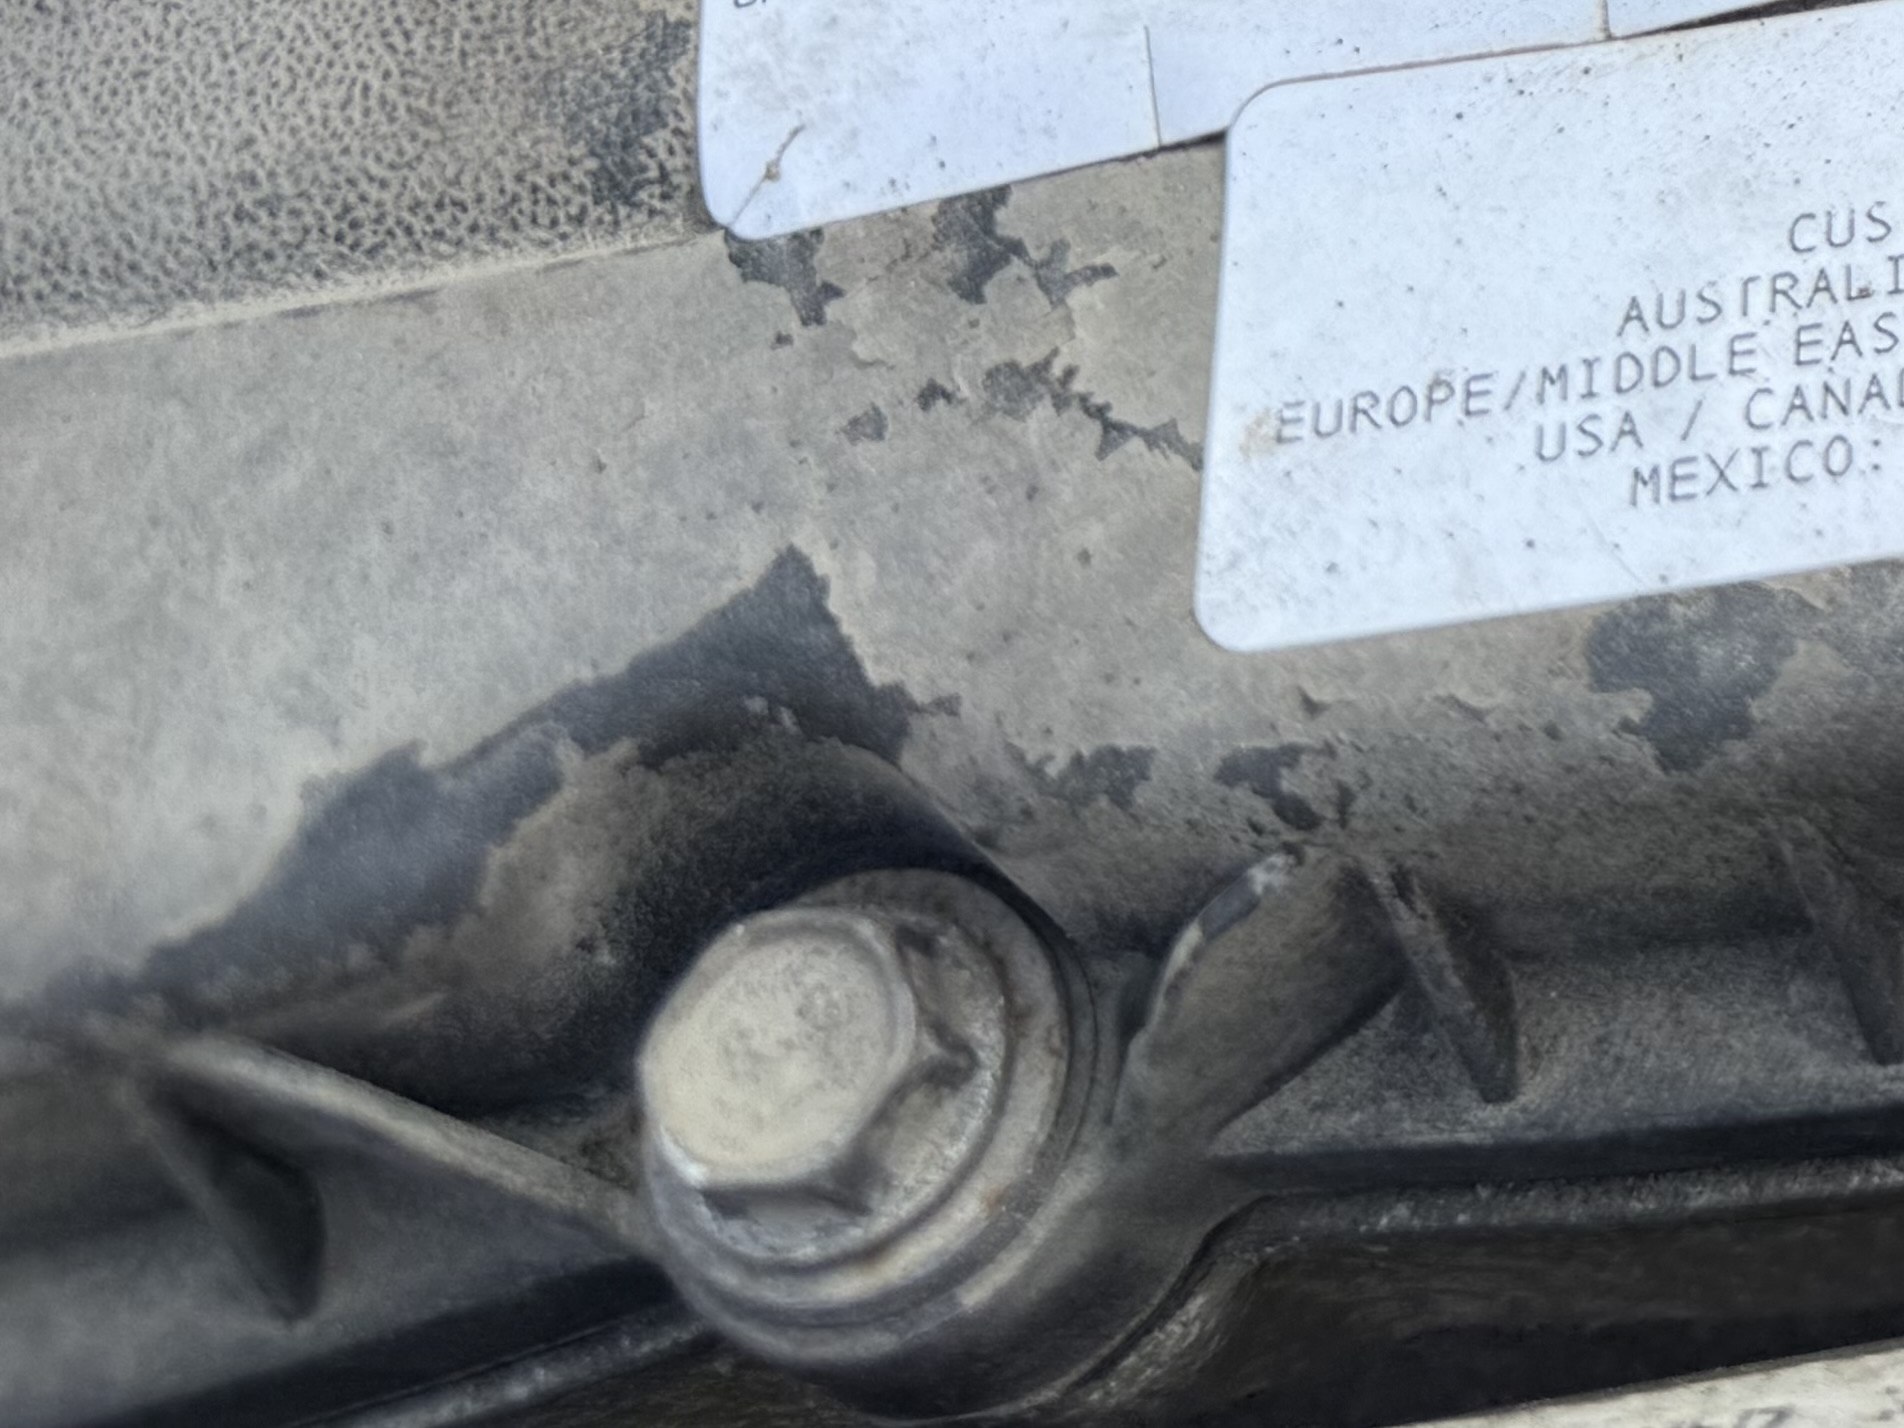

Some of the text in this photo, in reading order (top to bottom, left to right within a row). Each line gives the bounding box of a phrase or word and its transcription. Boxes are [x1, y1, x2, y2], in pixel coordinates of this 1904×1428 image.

[1273, 331, 1758, 446] EUROPE/MIDDLE
[1534, 408, 1644, 465] USA
[1678, 398, 1702, 442] /
[1629, 432, 1882, 509] MEXICO:
